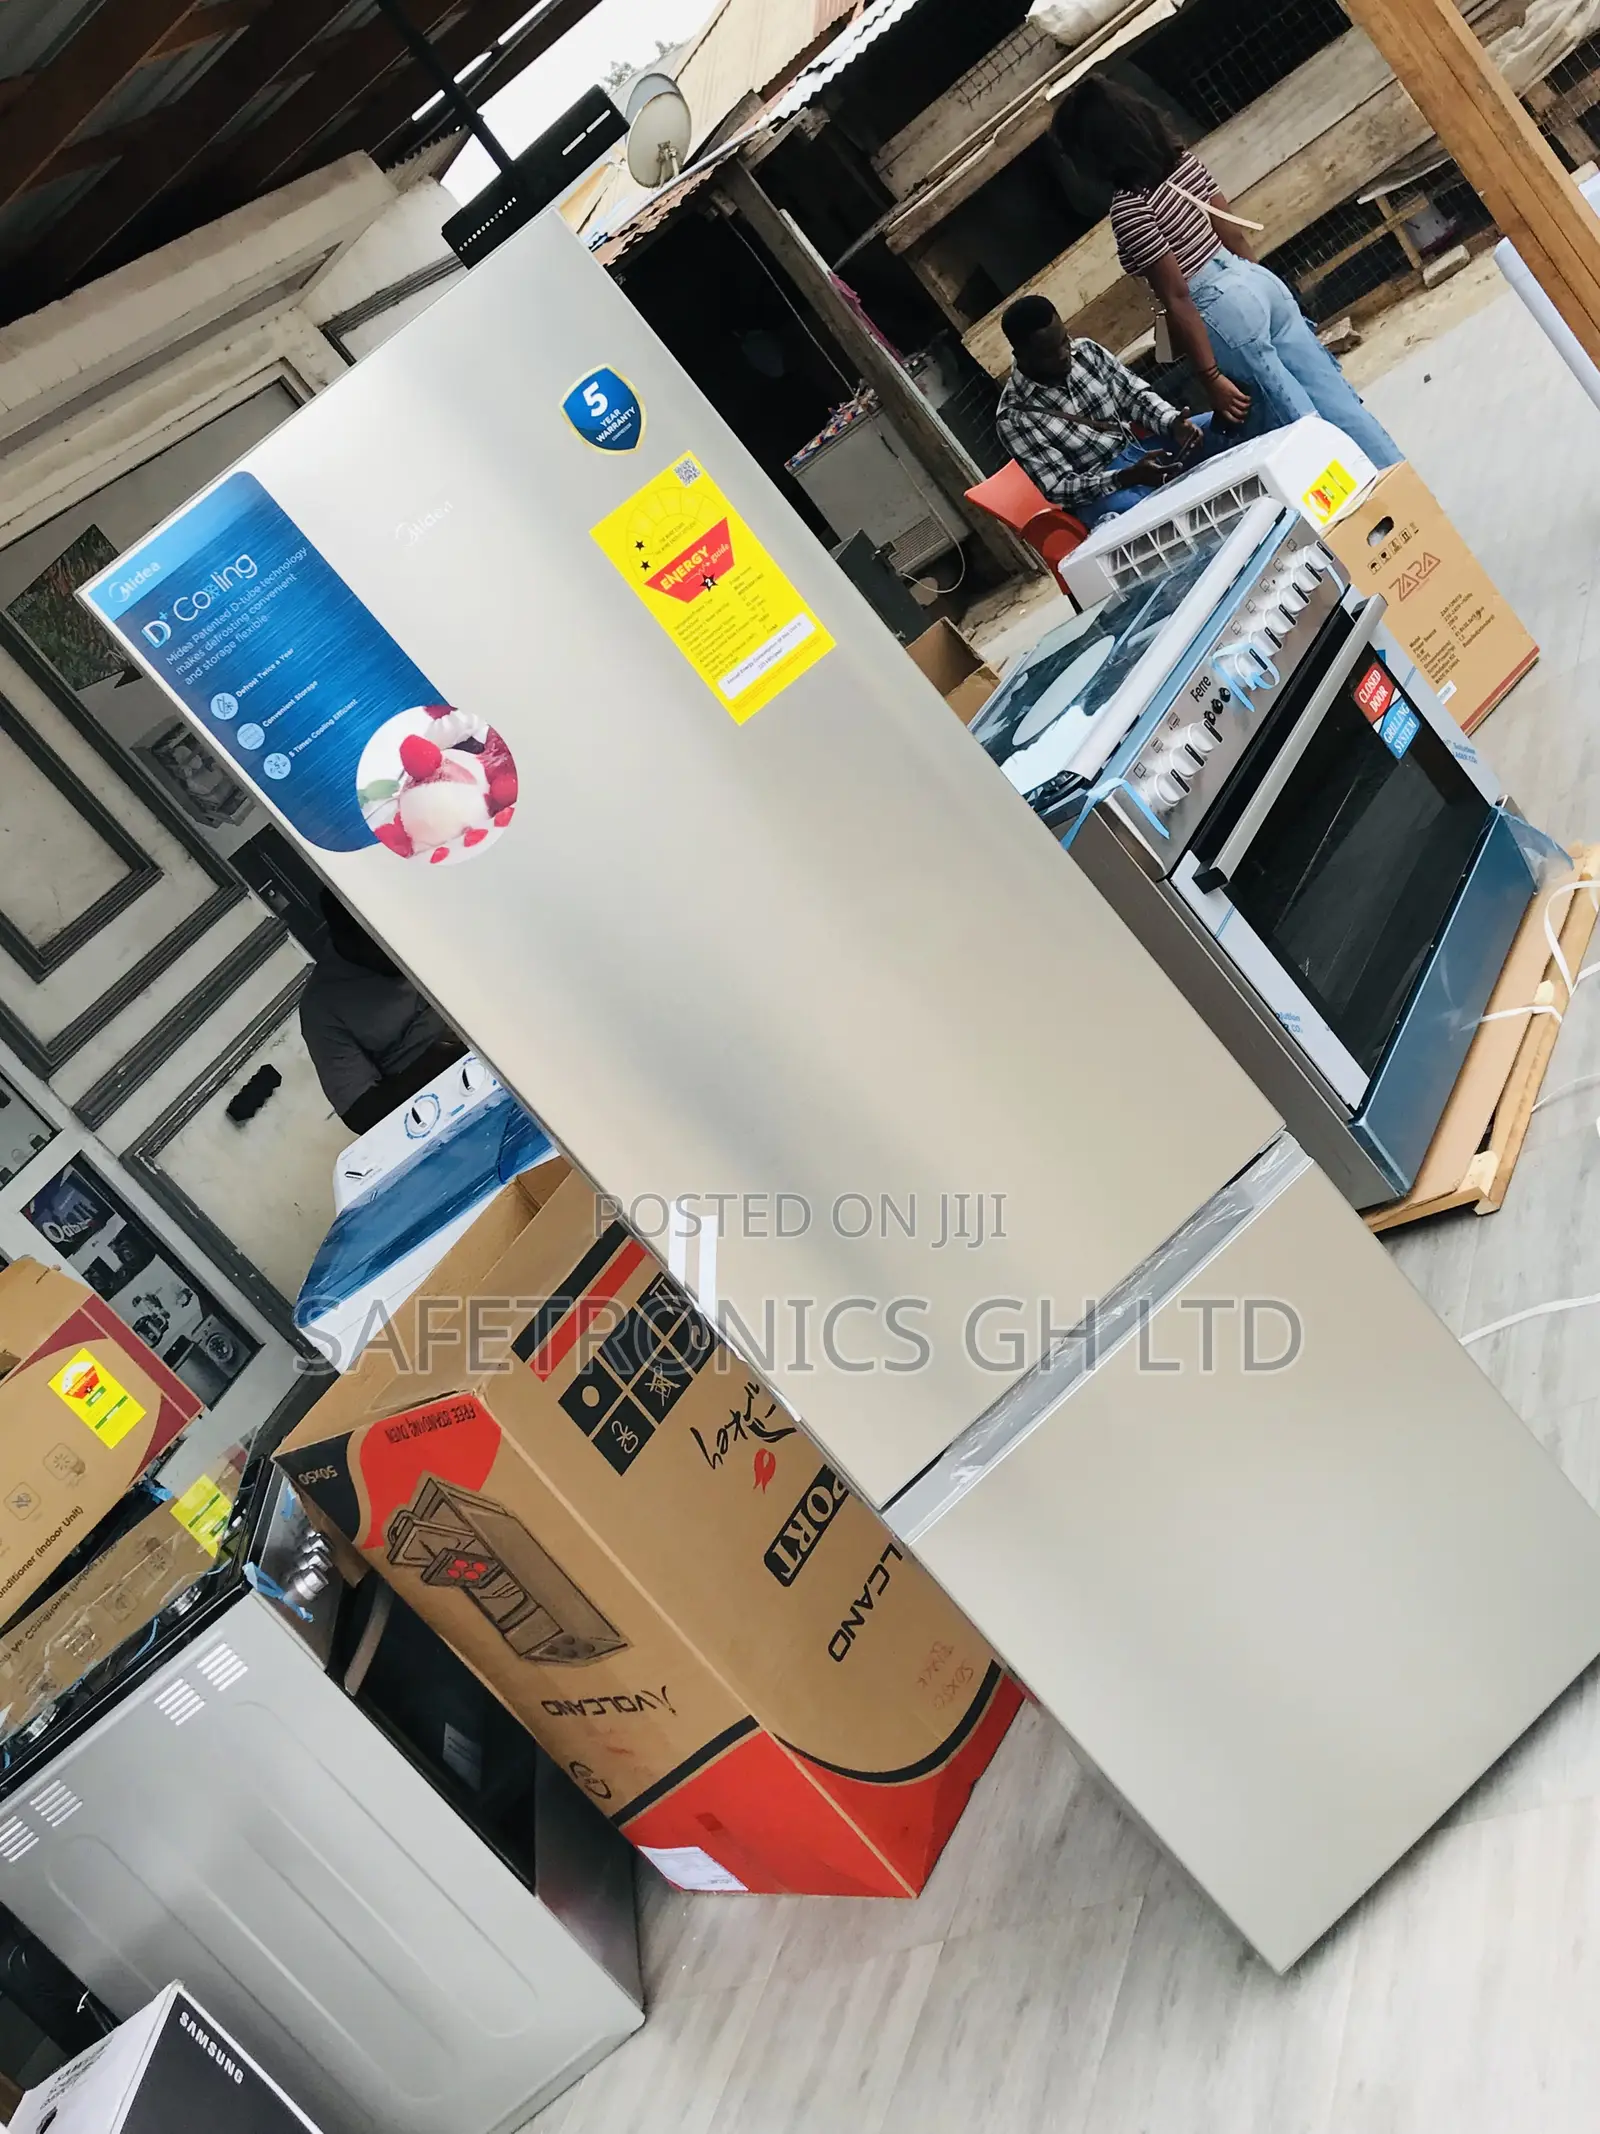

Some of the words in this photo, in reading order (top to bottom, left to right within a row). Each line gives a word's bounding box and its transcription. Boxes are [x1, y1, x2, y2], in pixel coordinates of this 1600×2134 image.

[582, 381, 608, 417] 5
[600, 408, 622, 428] YEAR
[595, 406, 636, 443] WARRANTY
[108, 561, 161, 603] Midea
[660, 545, 709, 590] ENERGY
[705, 578, 713, 587] 2
[1388, 551, 1441, 602] ZARA
[166, 638, 195, 665] Midea
[193, 609, 232, 645] Patented
[229, 586, 261, 614] D-tube
[259, 546, 308, 588] technology
[175, 648, 206, 676] makes
[203, 612, 251, 651] defrosting
[249, 572, 298, 615] convenient
[184, 667, 204, 686] and
[203, 640, 237, 672] storage
[235, 677, 259, 698] Defrost
[257, 663, 277, 680] Twice
[279, 648, 294, 661] Year
[262, 698, 297, 728] Convenient
[294, 680, 319, 702] Storage
[1190, 676, 1212, 703] Ferre
[1358, 669, 1382, 704] CLOSED
[1369, 685, 1389, 713] DOOR
[292, 737, 314, 754] Times
[311, 717, 336, 740] Cooling
[1383, 702, 1410, 744] GRILLING
[453, 1402, 477, 1424] FREE
[35, 1525, 64, 1558] (Indoor
[62, 1505, 84, 1528] Unit)
[541, 1694, 657, 1716] VOLCANO
[179, 2011, 244, 2084] SAMSUNG
